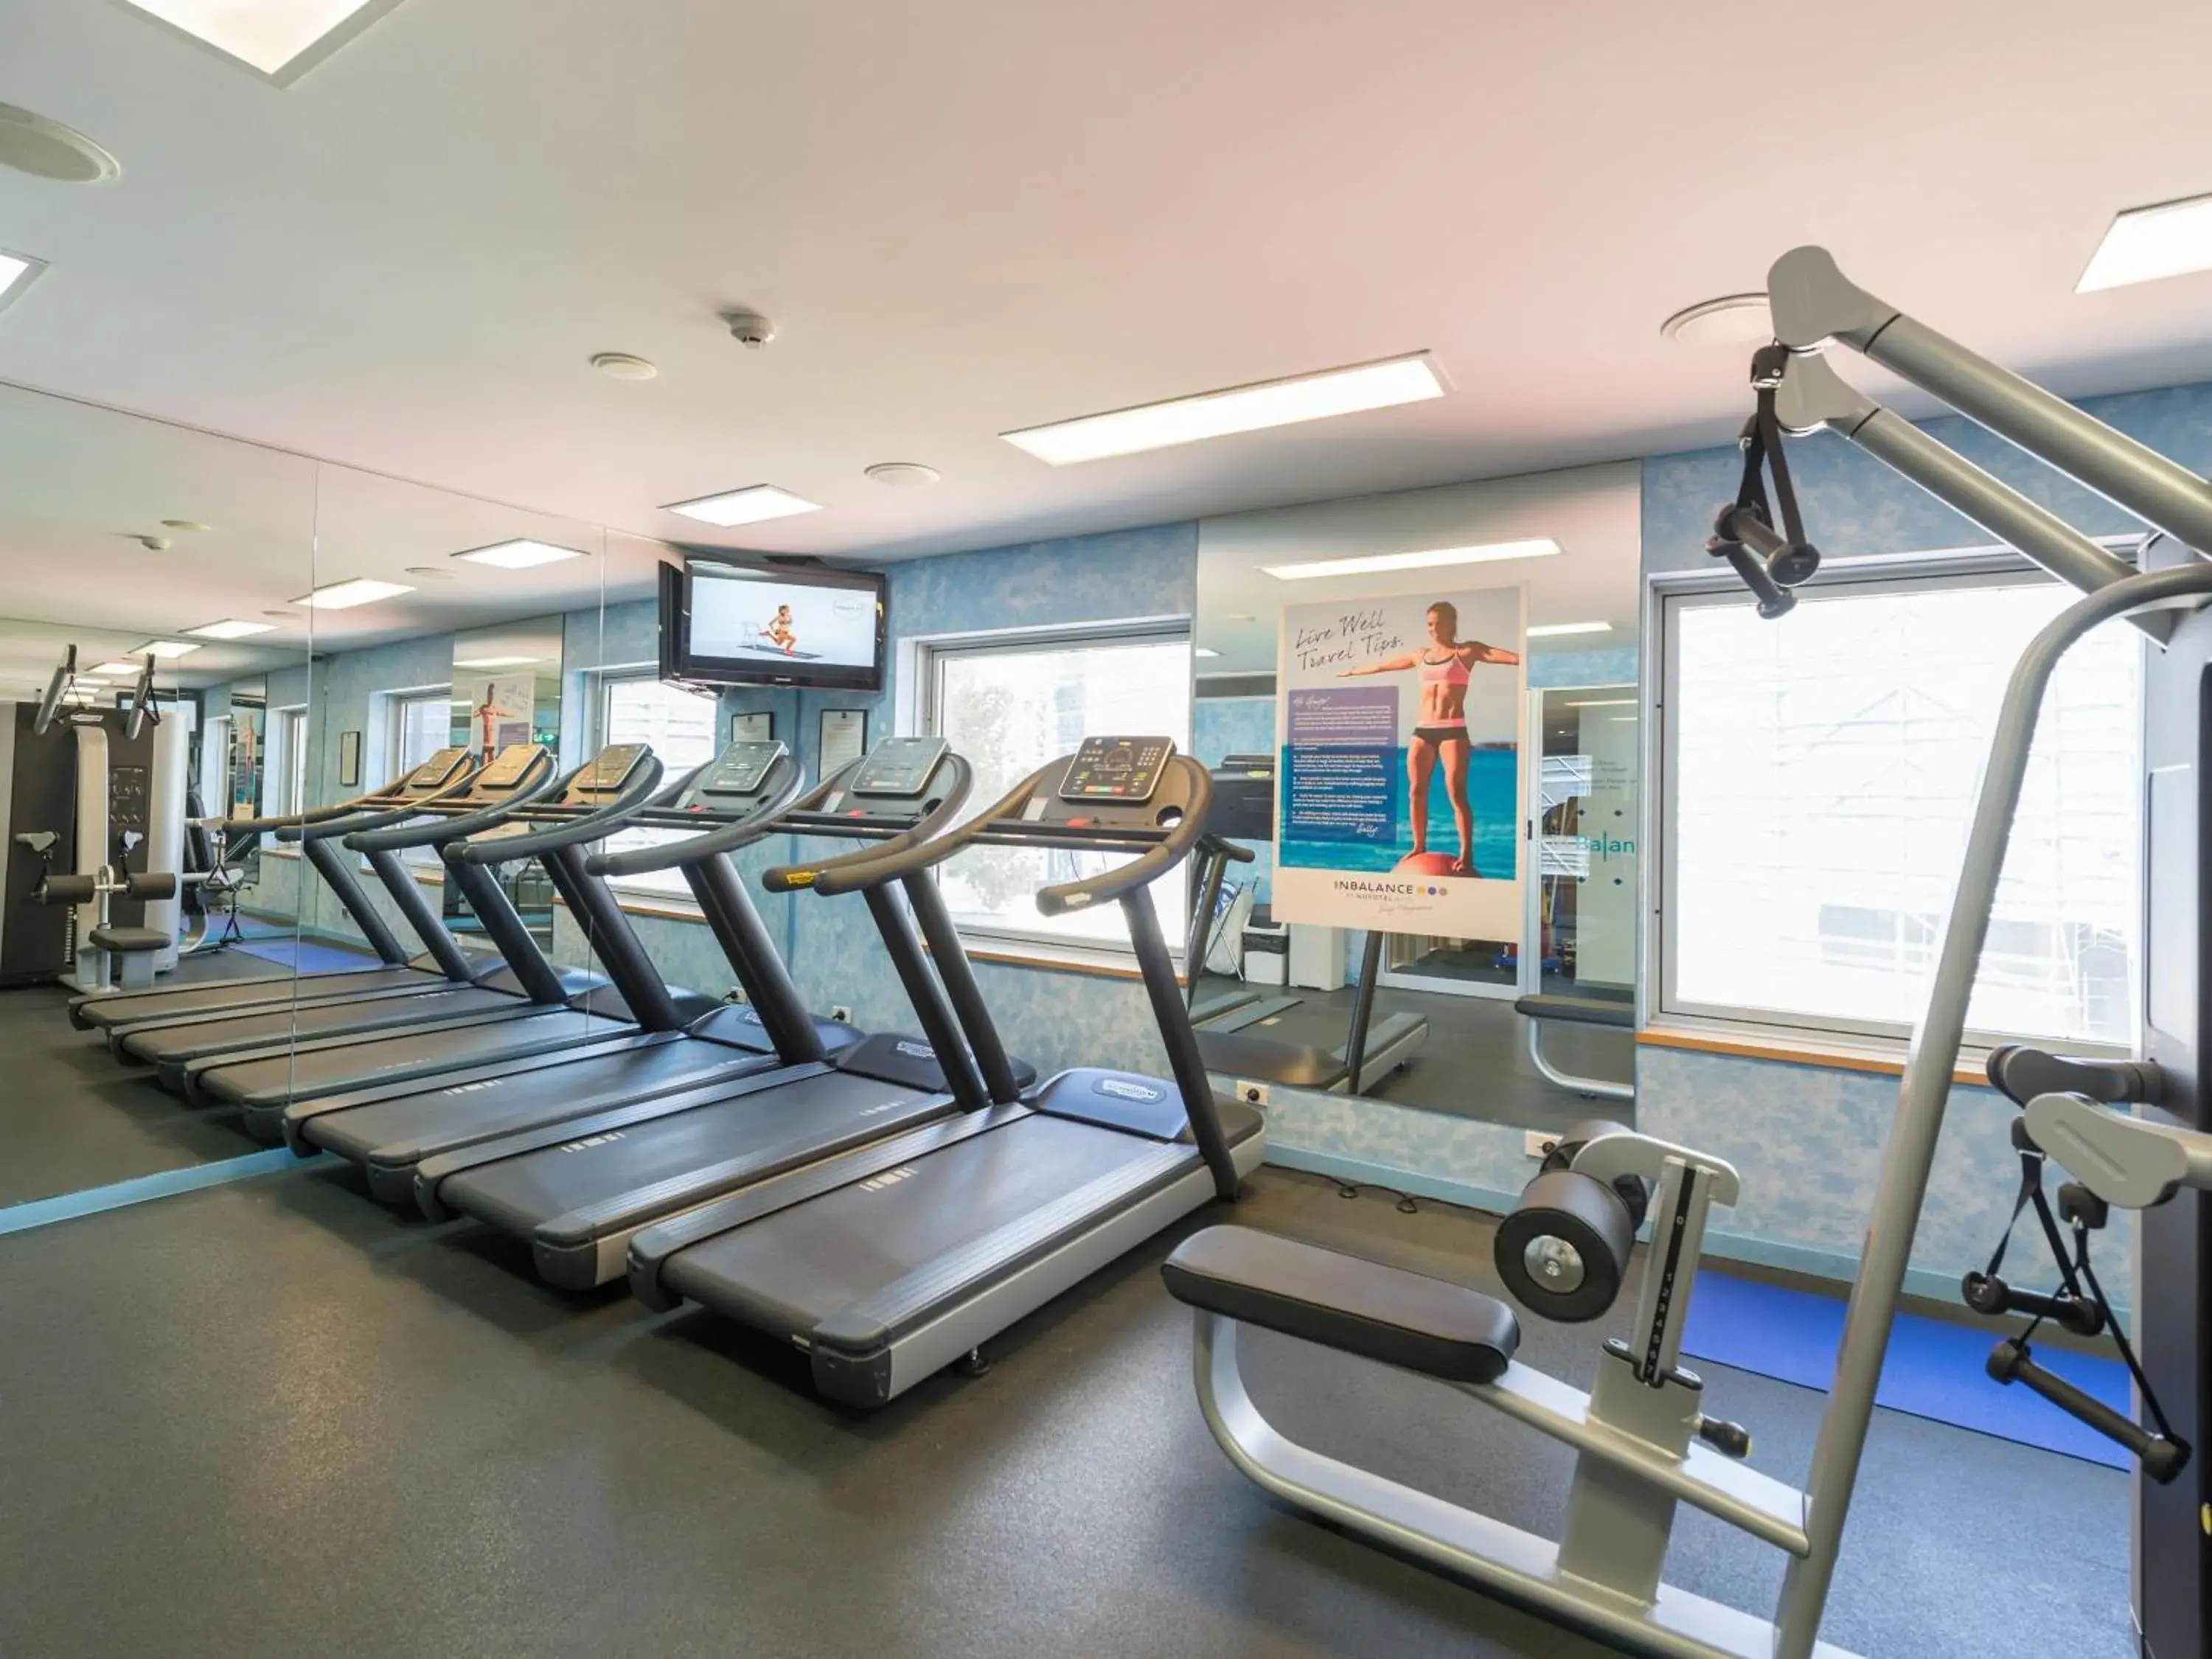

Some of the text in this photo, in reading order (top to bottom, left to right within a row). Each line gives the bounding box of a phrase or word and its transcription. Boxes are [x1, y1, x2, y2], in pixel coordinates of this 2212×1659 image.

[1295, 609, 1385, 650] Live Well
[1298, 641, 1355, 670] Travel
[1334, 880, 1413, 894] INBALANCE
